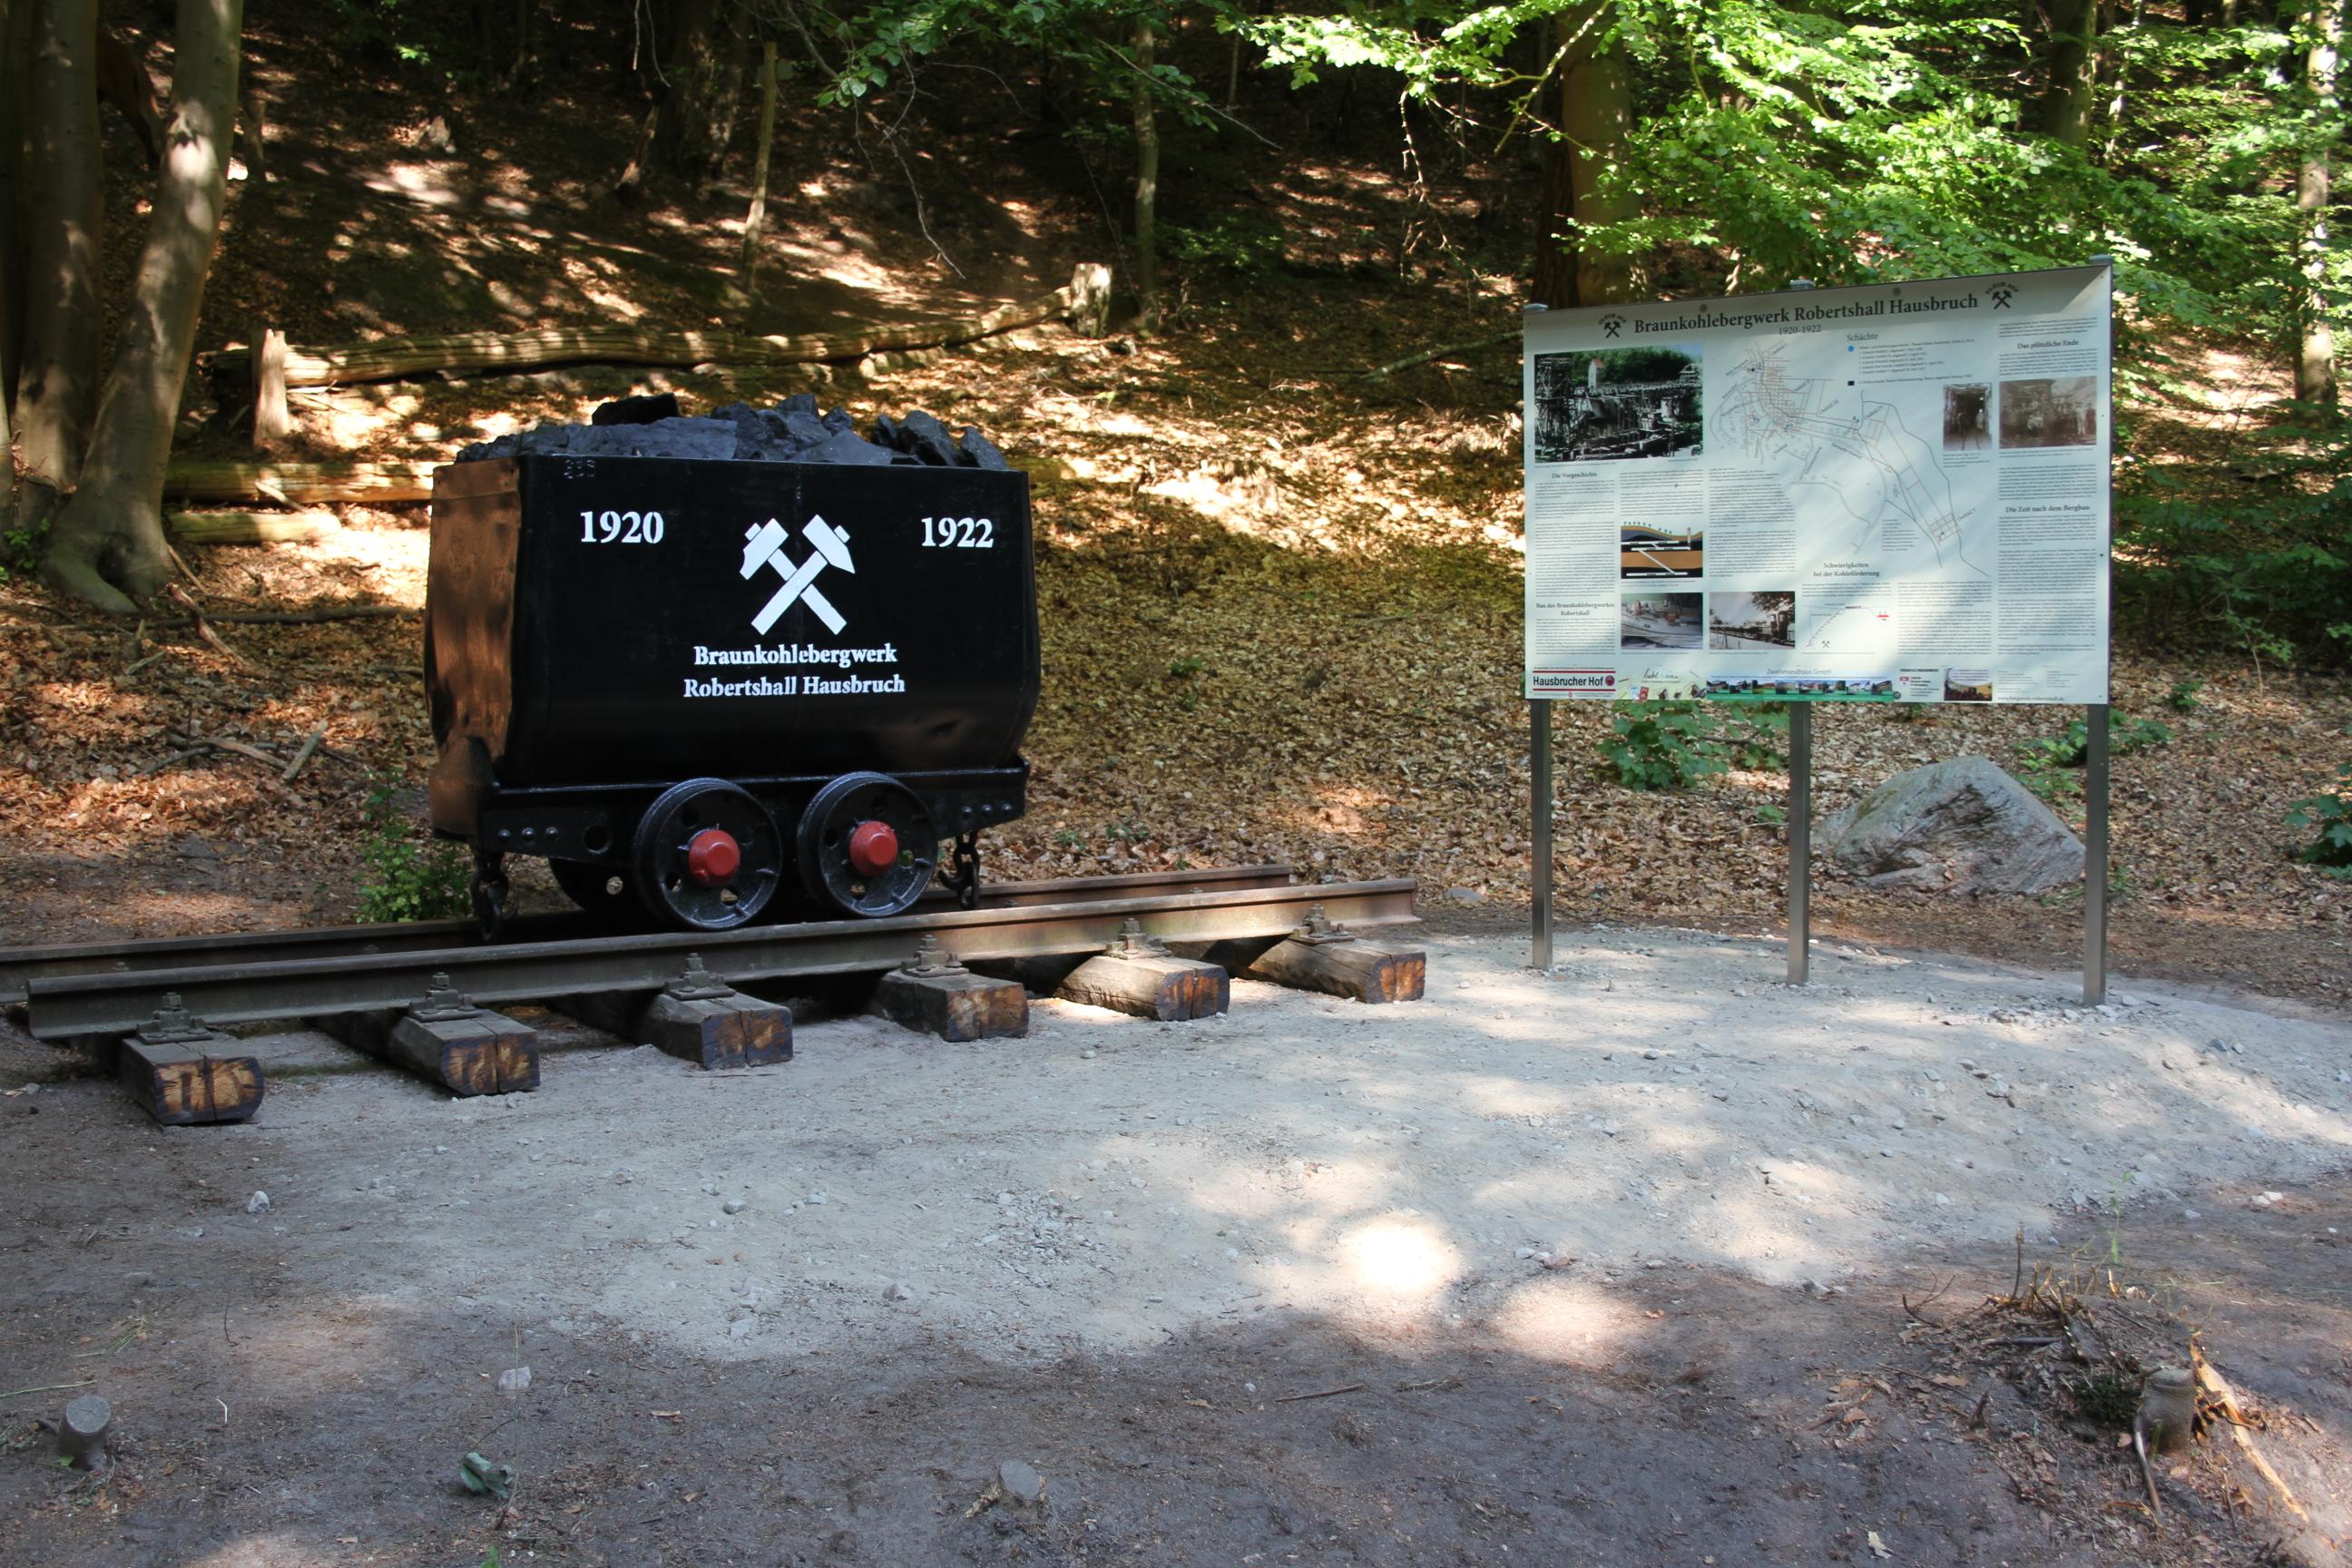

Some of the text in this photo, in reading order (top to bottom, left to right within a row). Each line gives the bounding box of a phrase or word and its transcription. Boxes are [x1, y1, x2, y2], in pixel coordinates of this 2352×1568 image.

[1633, 293, 1978, 333] Braunkohlebergwerk Robertshall Hausbruch
[1779, 324, 1822, 336] 1920-1922
[1847, 332, 1879, 342] Schächte
[2063, 505, 2091, 513] Bergbau
[580, 510, 664, 544] 1920
[921, 516, 995, 549] 1922
[693, 642, 898, 668] Braunkohlebergwerk
[683, 673, 906, 698] Robertshall Hausbruch
[1533, 676, 1603, 687] Hausbrucher Hof
